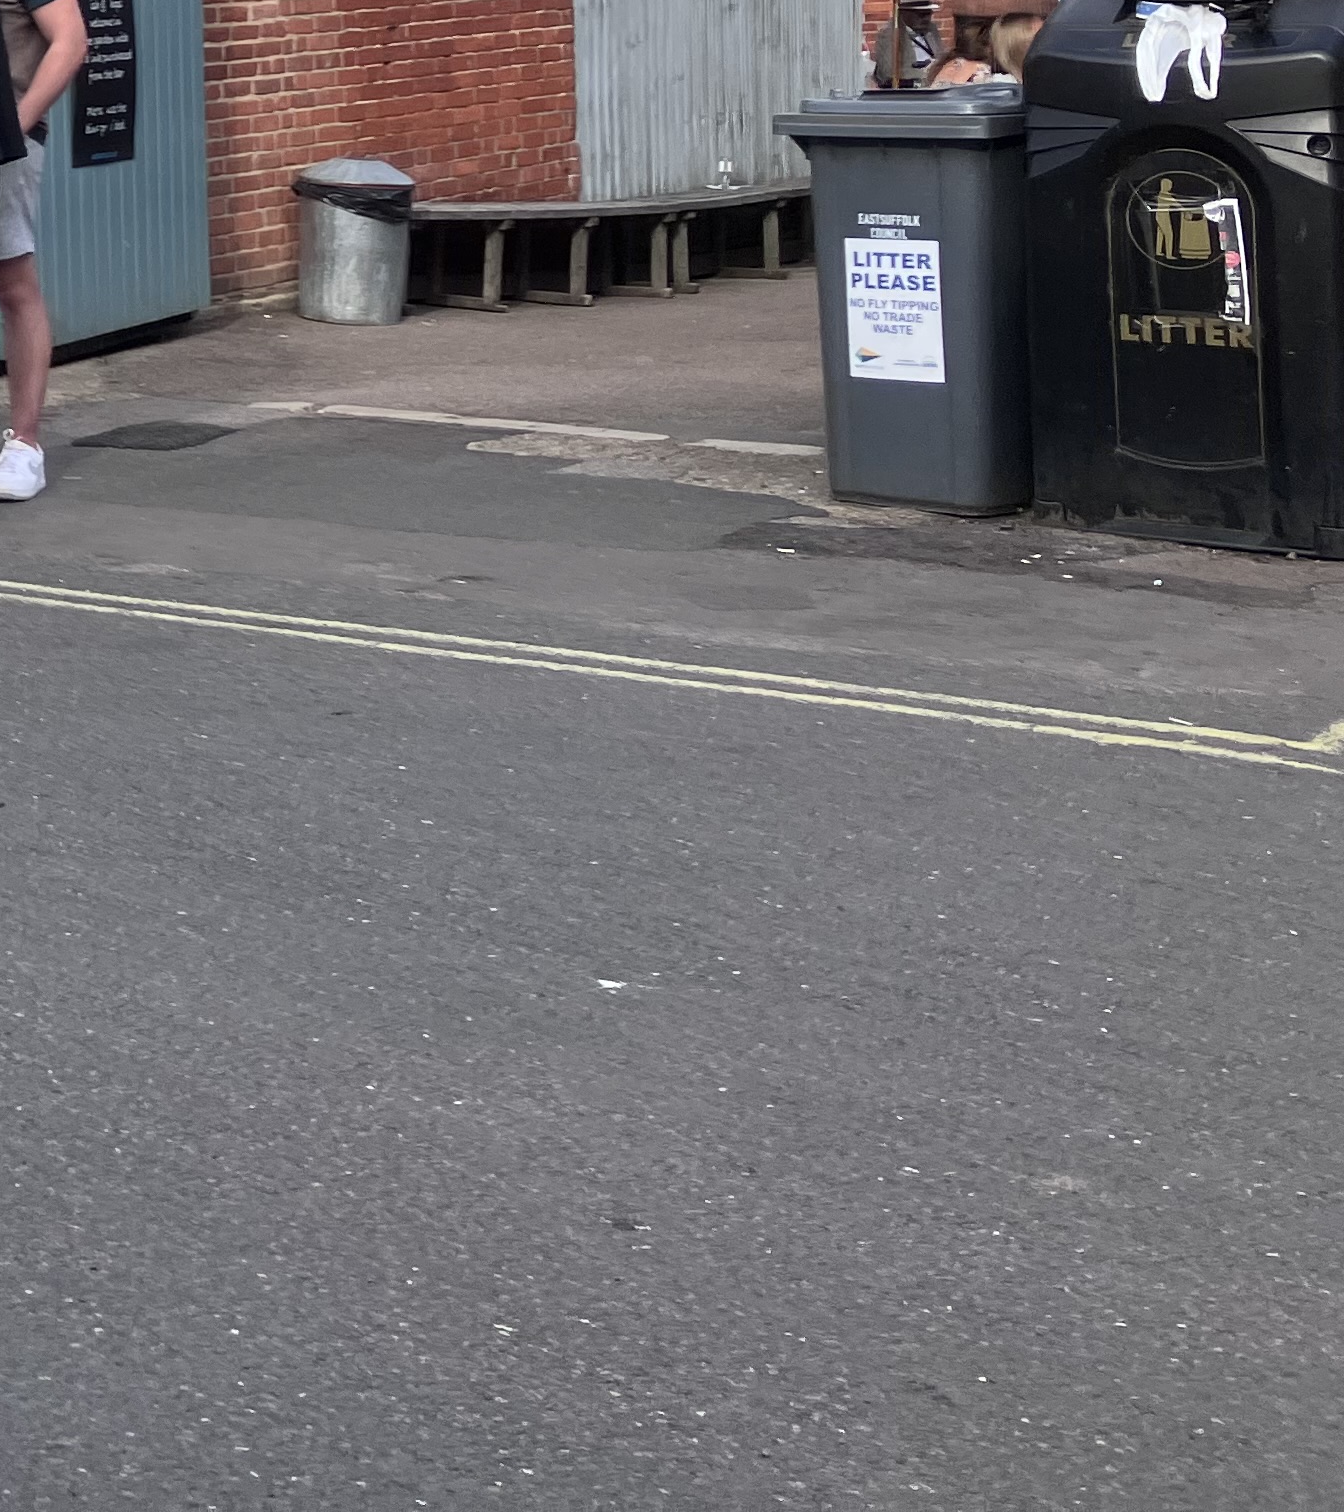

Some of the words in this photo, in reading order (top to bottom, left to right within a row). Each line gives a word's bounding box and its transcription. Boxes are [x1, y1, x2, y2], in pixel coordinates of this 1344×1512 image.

[853, 251, 932, 270] LITTER
[851, 272, 937, 292] PLEASE
[850, 298, 866, 308] NO
[867, 298, 889, 309] FLY
[890, 299, 940, 312] TIPPING
[864, 311, 880, 321] NO
[882, 312, 924, 324] TRADE
[872, 324, 914, 336] WASTE
[1119, 313, 1255, 349] LITTER
